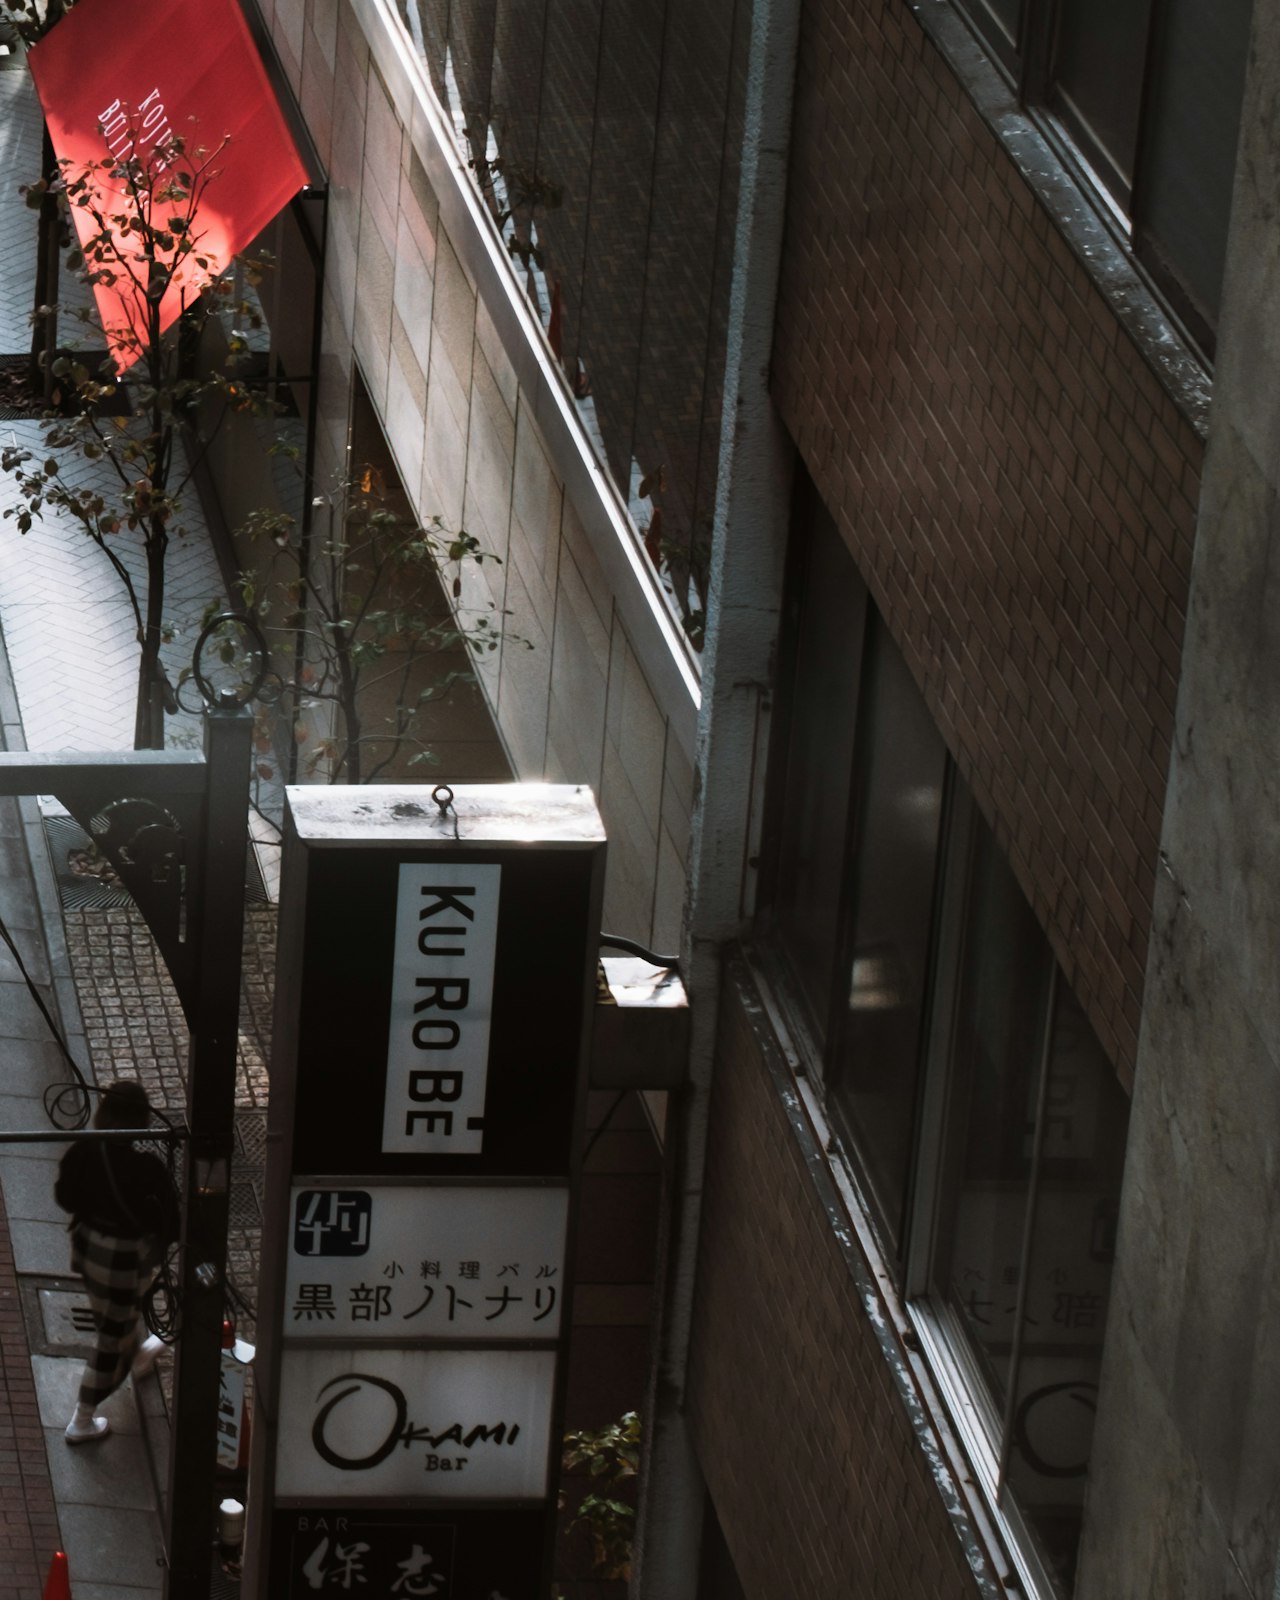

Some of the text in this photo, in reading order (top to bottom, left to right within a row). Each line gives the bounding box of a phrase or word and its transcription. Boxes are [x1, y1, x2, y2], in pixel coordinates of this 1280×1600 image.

[383, 1260, 557, 1280] 小料理バル
[292, 1283, 557, 1321] 黒部ノトナリ
[425, 1454, 468, 1472] Bar
[298, 1517, 350, 1532] BAR
[302, 1536, 446, 1596] 保志
